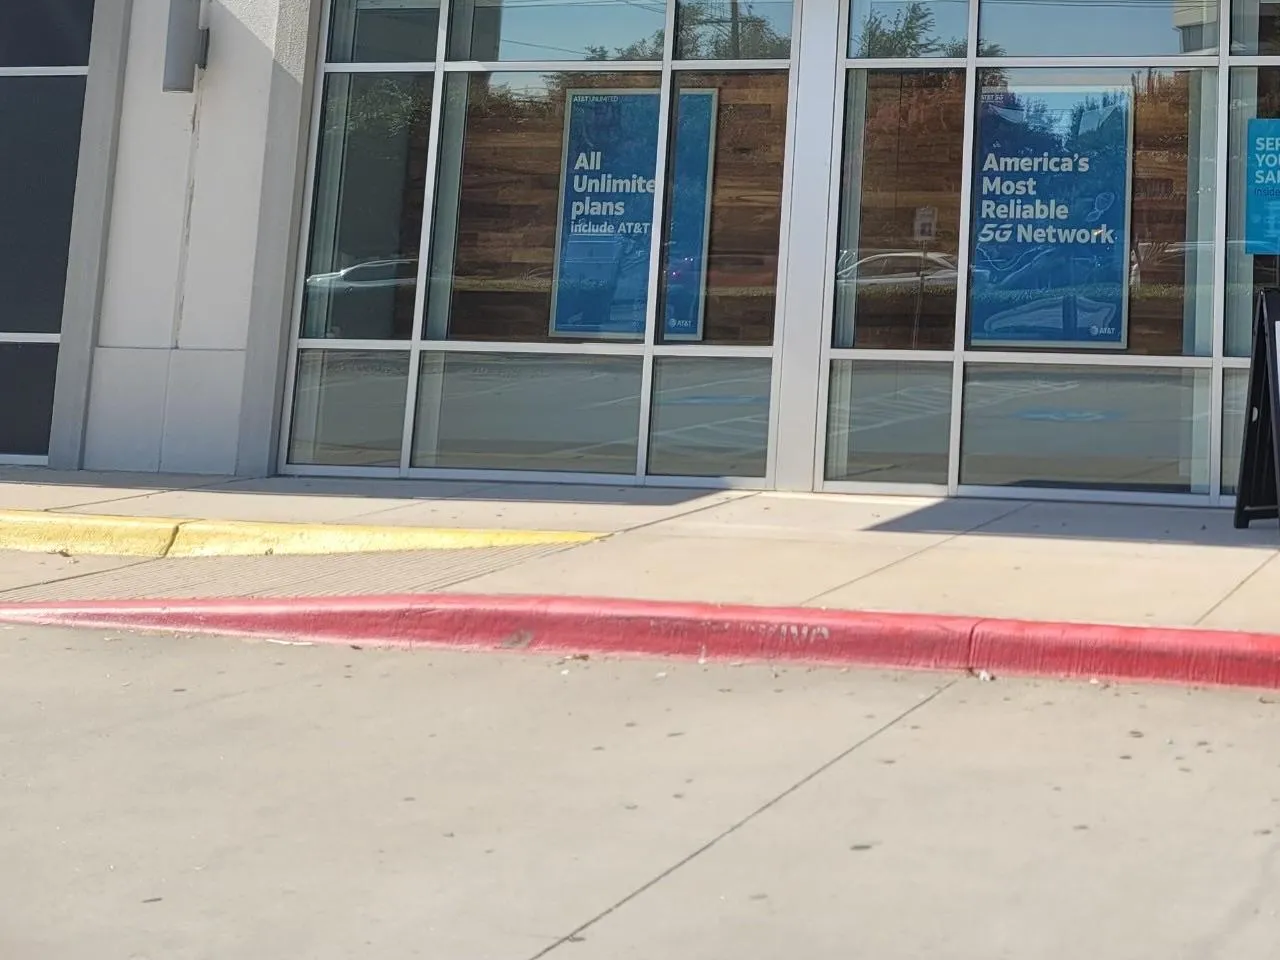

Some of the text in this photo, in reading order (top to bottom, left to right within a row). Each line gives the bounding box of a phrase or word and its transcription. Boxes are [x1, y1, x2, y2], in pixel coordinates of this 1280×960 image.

[574, 151, 601, 170] All
[982, 152, 1089, 172] America's
[573, 174, 657, 194] Unlimite
[982, 176, 1037, 195] Most
[1255, 187, 1280, 197] Inside
[571, 196, 625, 220] plans
[981, 199, 1069, 219] Reliable
[570, 220, 650, 234] include AT&T
[979, 223, 1114, 244] 5G Network
[677, 319, 692, 328] AT&T
[1100, 327, 1115, 335] AT&T
